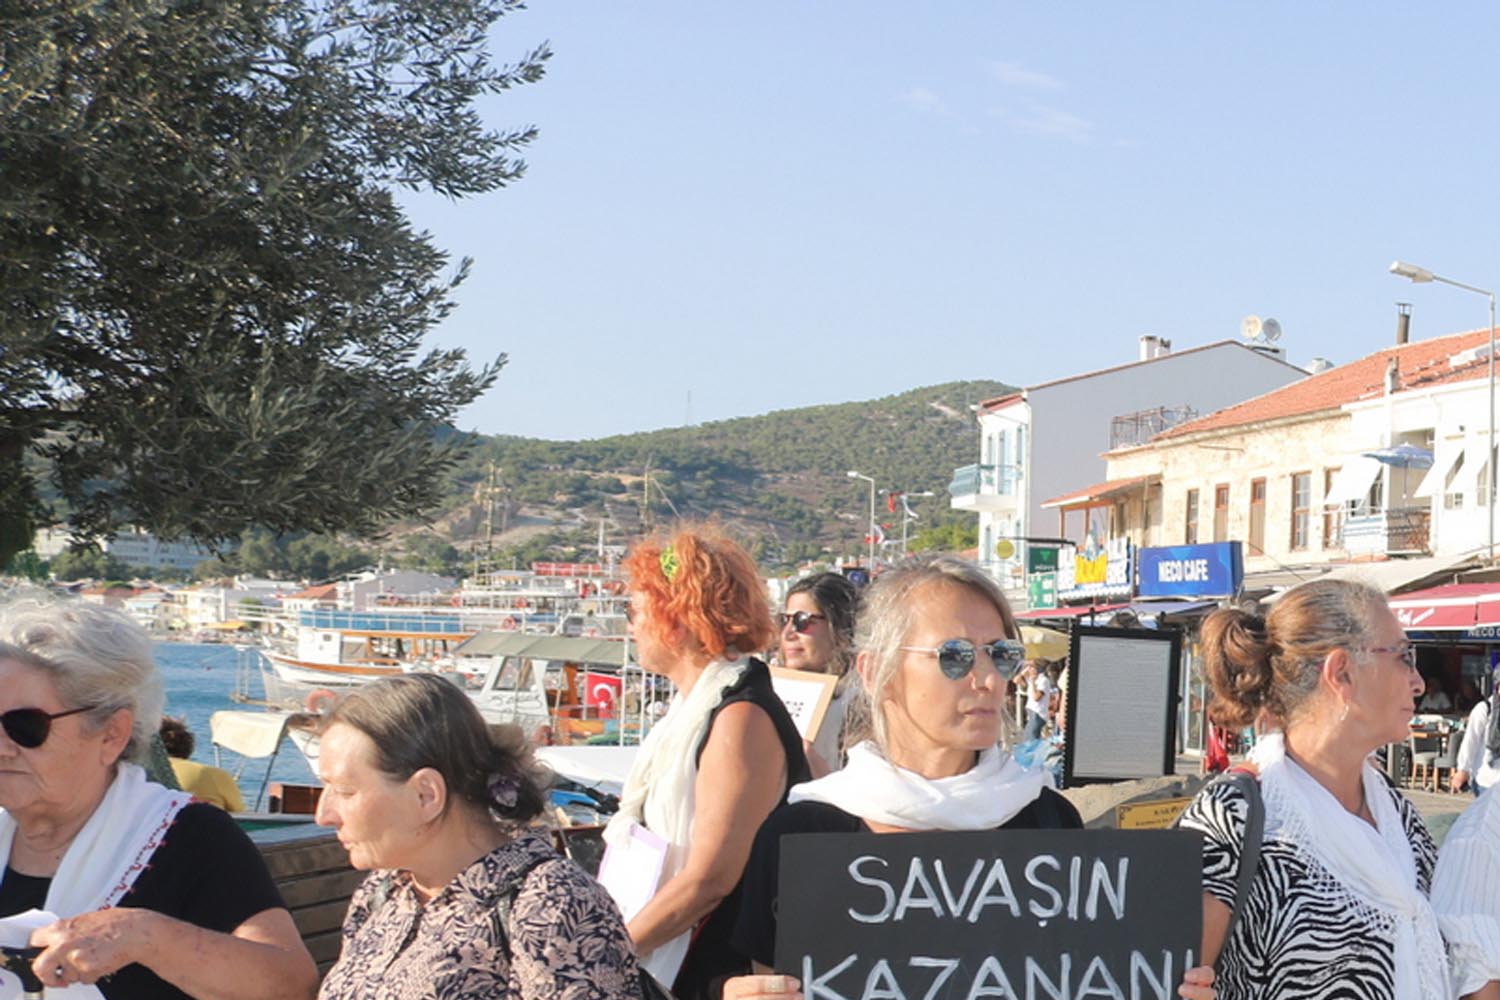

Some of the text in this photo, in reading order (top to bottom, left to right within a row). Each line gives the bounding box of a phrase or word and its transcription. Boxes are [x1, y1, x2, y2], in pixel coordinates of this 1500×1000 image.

[1158, 559, 1208, 582] NECO CAFE
[847, 854, 1130, 928] SAVAŞIN
